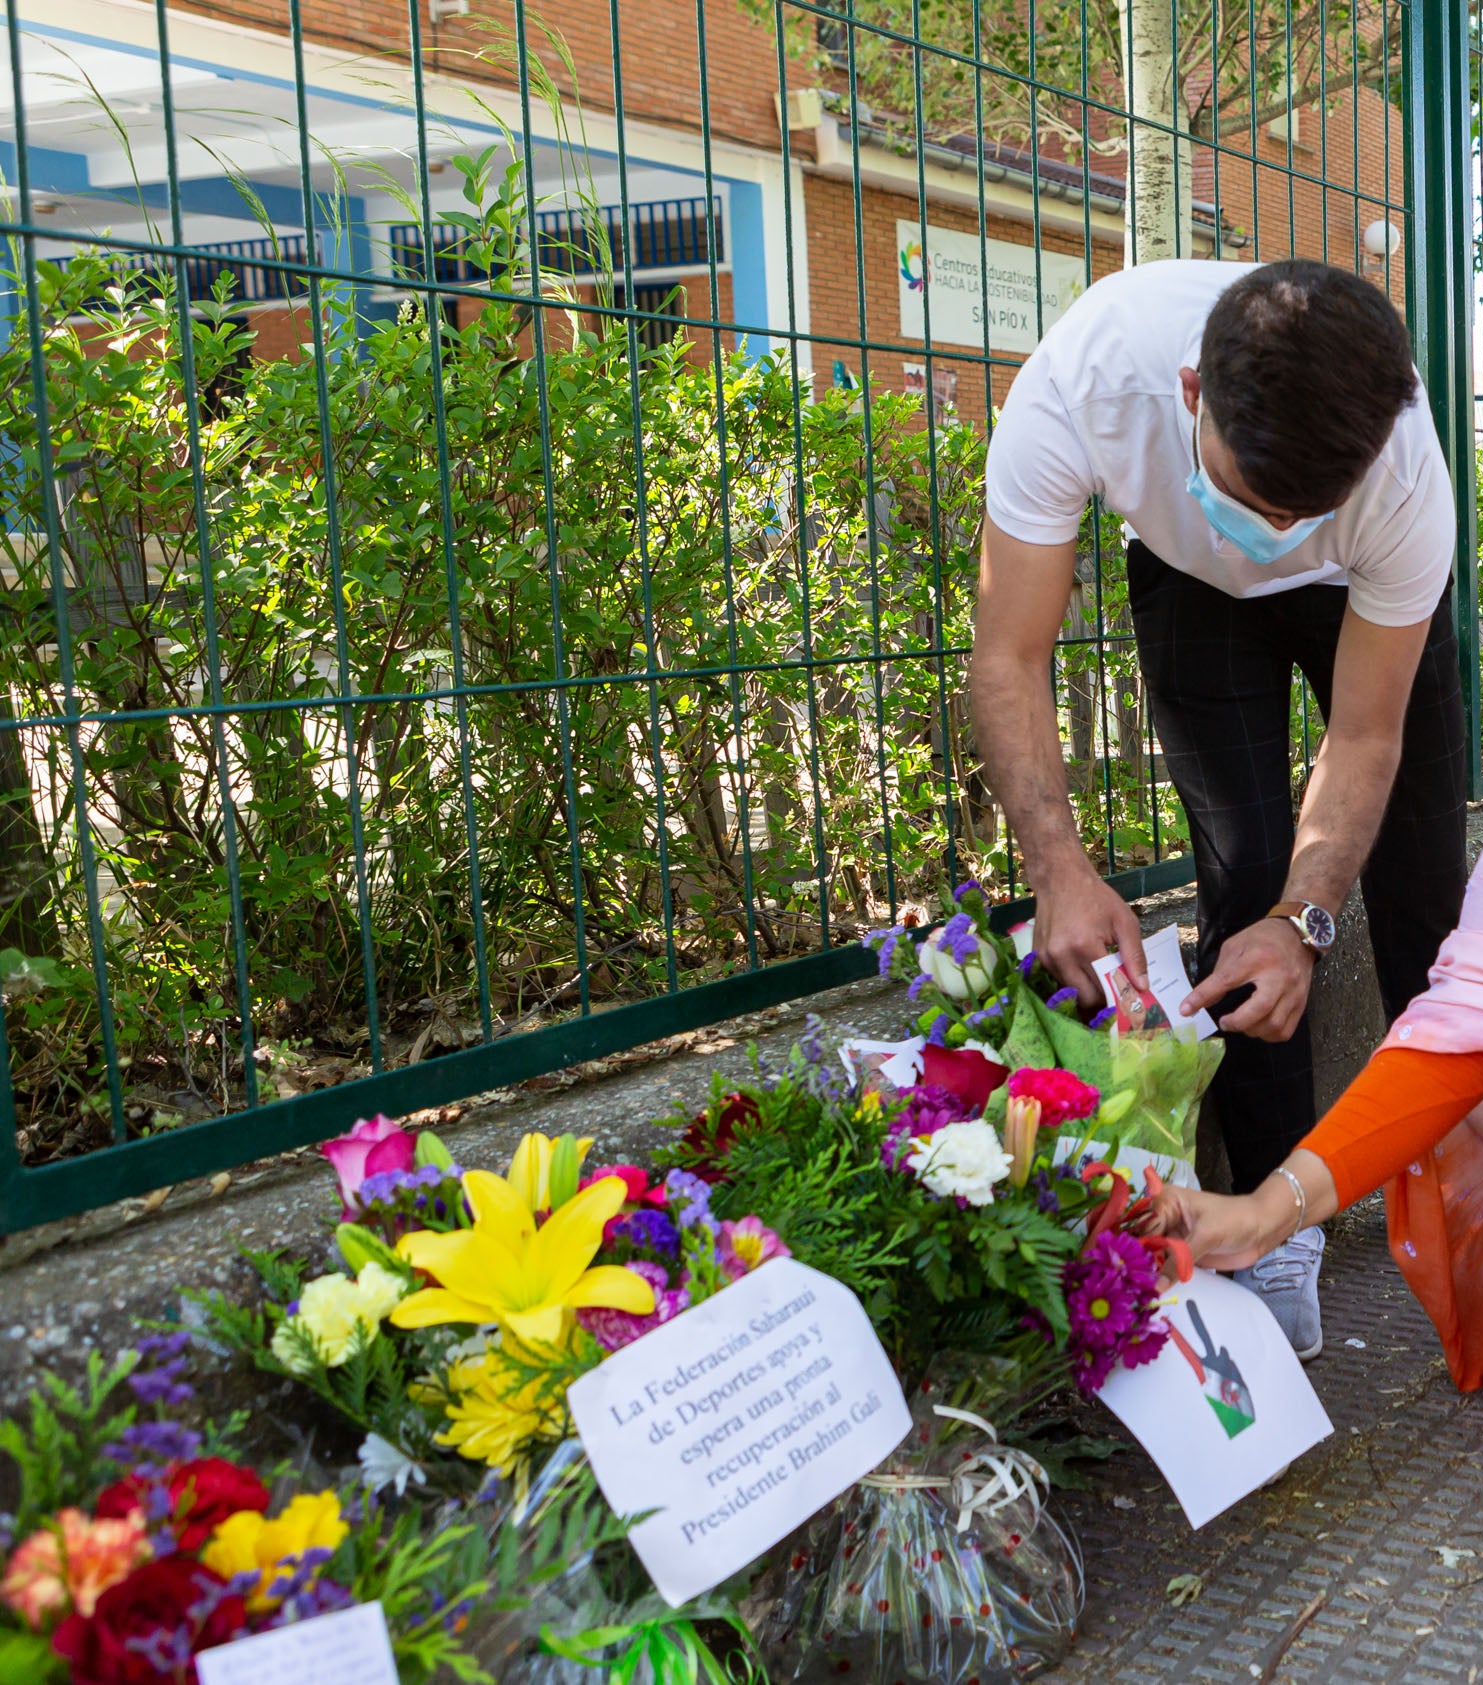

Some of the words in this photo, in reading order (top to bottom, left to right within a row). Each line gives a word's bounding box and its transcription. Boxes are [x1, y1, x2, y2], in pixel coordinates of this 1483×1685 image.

[933, 253, 978, 276] Centros
[983, 262, 1037, 287] ducativos
[934, 273, 966, 289] HACIA
[968, 281, 979, 292] LA
[983, 282, 1057, 307] OSTENIBILDAD
[1021, 314, 1028, 330] X
[609, 1398, 644, 1427] La
[643, 1330, 754, 1406] Federación
[748, 1285, 817, 1346] Saharaui
[647, 1420, 673, 1446] de
[676, 1362, 768, 1427] Deportes
[765, 1330, 812, 1371] apoya
[812, 1323, 825, 1344] y
[679, 1415, 745, 1467] espera
[746, 1389, 785, 1422] una
[785, 1354, 834, 1402] pronta
[680, 1461, 789, 1546] Presidente
[788, 1415, 853, 1471] Brahim
[849, 1389, 883, 1426] Gali
[705, 1396, 826, 1487] recuperación
[823, 1381, 843, 1415] al
